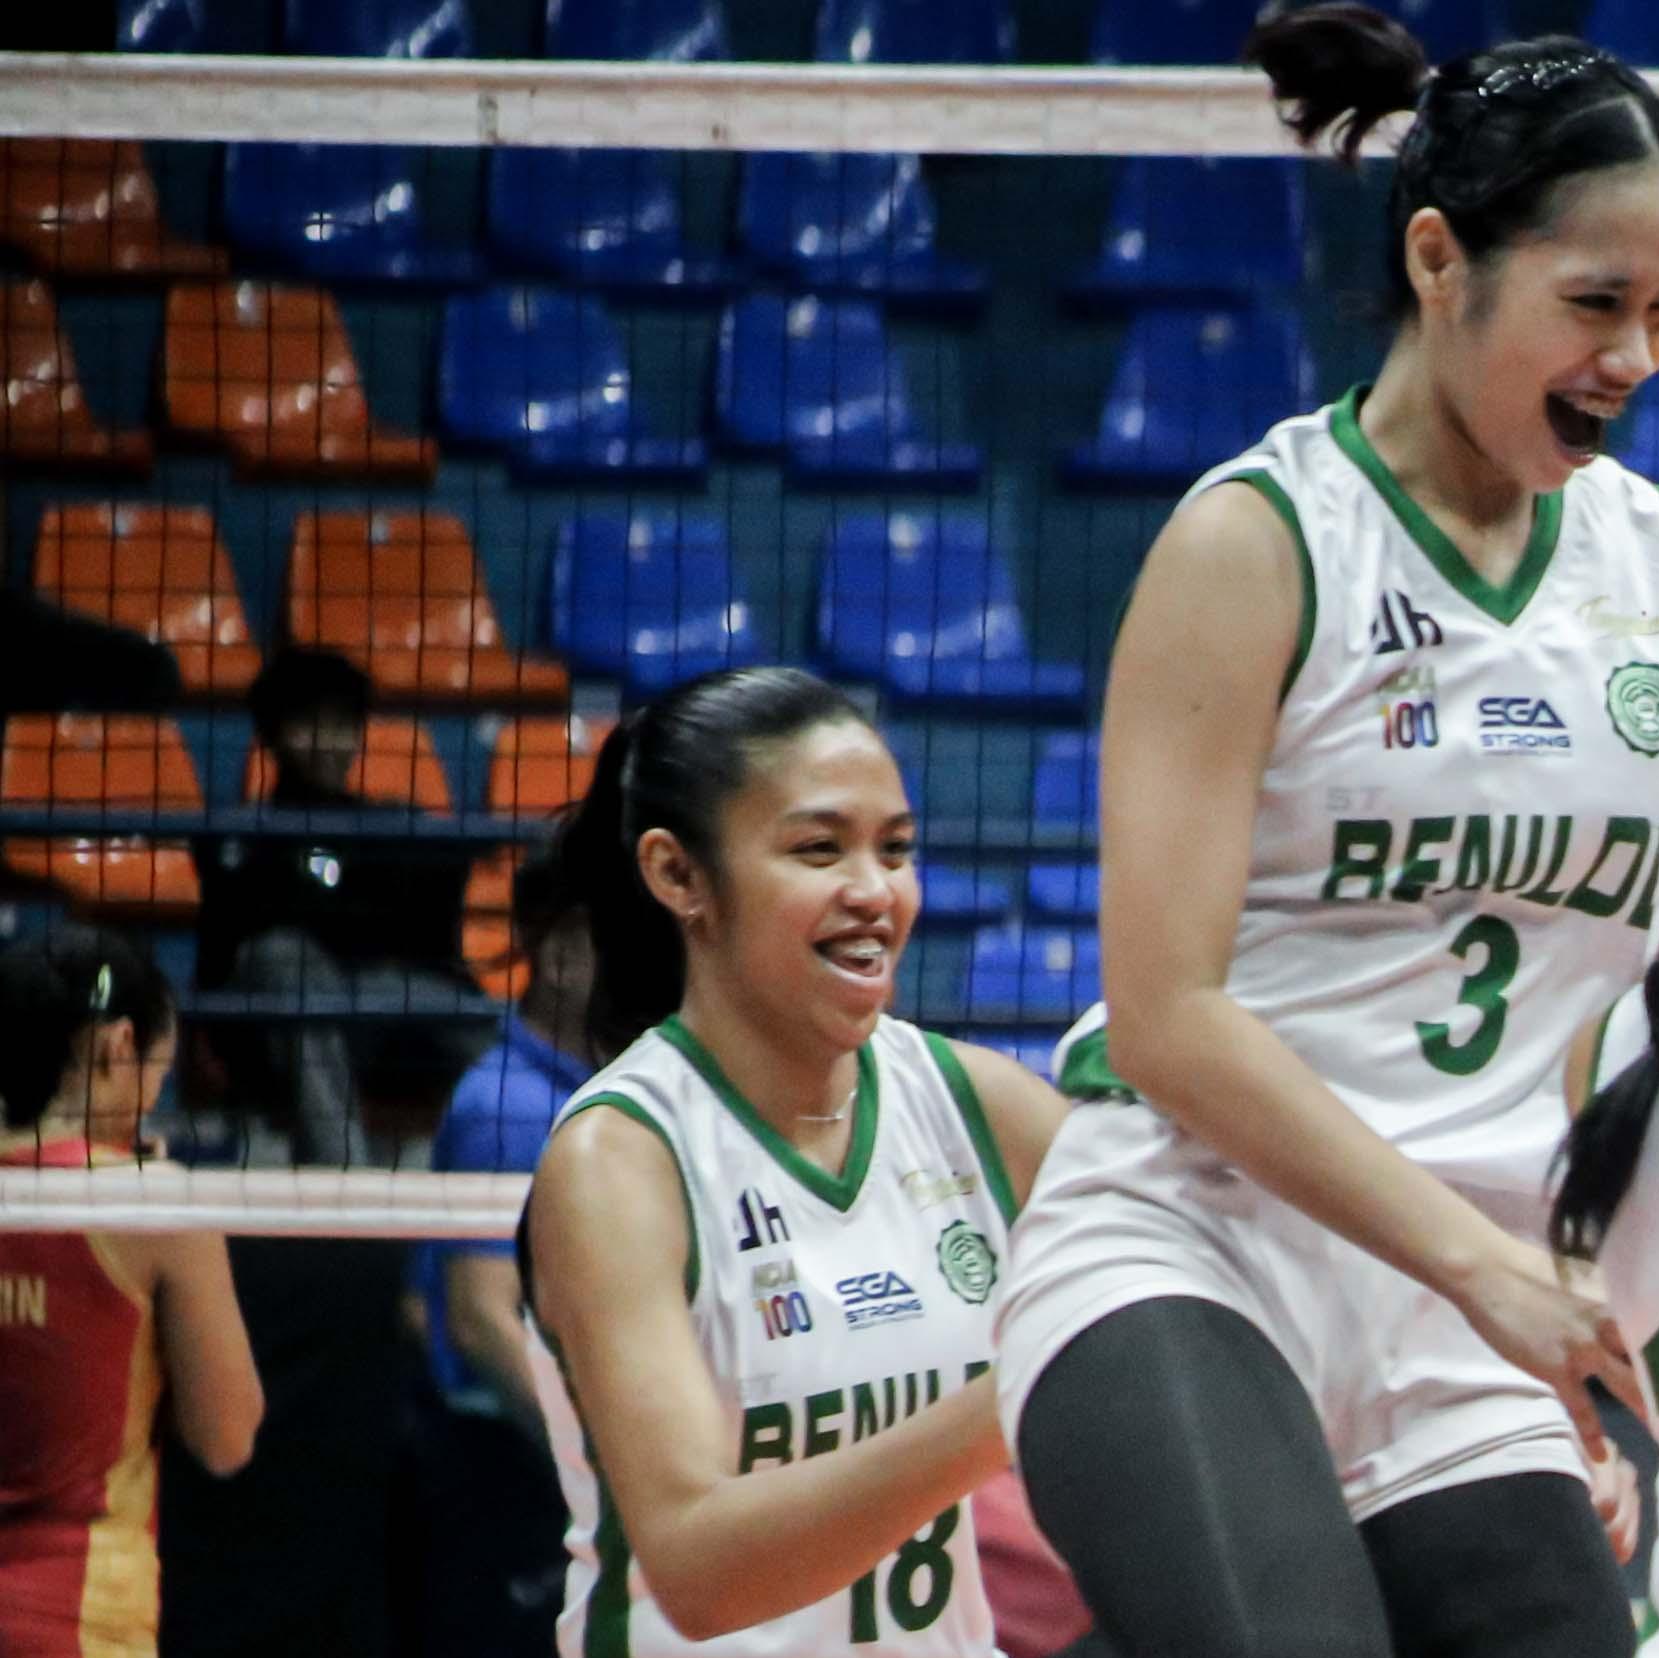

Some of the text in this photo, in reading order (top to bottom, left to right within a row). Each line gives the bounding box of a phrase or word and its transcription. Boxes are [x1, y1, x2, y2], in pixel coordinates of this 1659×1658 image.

[1379, 701, 1439, 750] 100
[1479, 698, 1567, 729] SGA
[1480, 734, 1572, 750] STRONG
[1413, 914, 1520, 1076] 3
[835, 1270, 915, 1306] SGA
[755, 1290, 813, 1341] 100
[844, 1299, 923, 1325] STRONG
